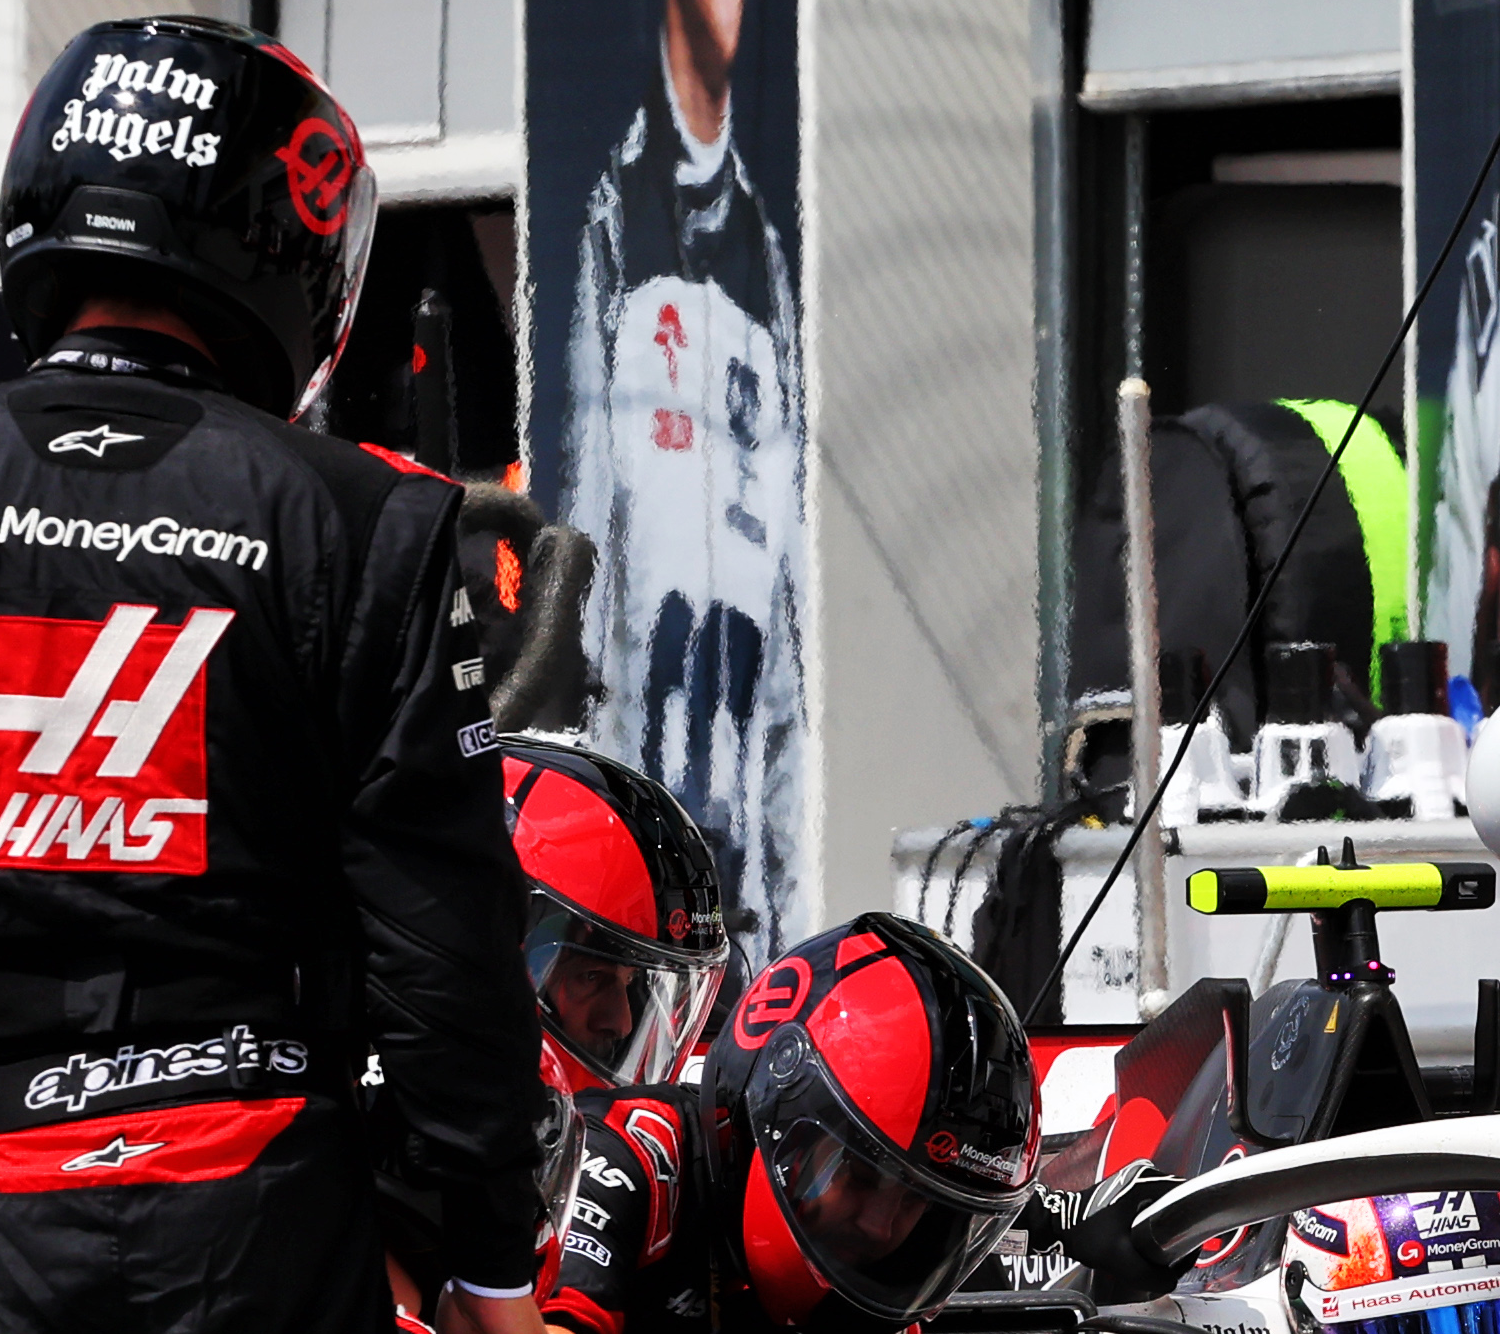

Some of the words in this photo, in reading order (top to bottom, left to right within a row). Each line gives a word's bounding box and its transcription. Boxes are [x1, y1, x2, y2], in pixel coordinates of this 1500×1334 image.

[82, 52, 220, 110] Palm
[52, 98, 222, 167] Angels
[84, 213, 136, 233] T.BROWN
[1426, 1215, 1472, 1238] HAAS
[1427, 1238, 1500, 1256] MoneyGram
[1352, 1294, 1402, 1310] Haas
